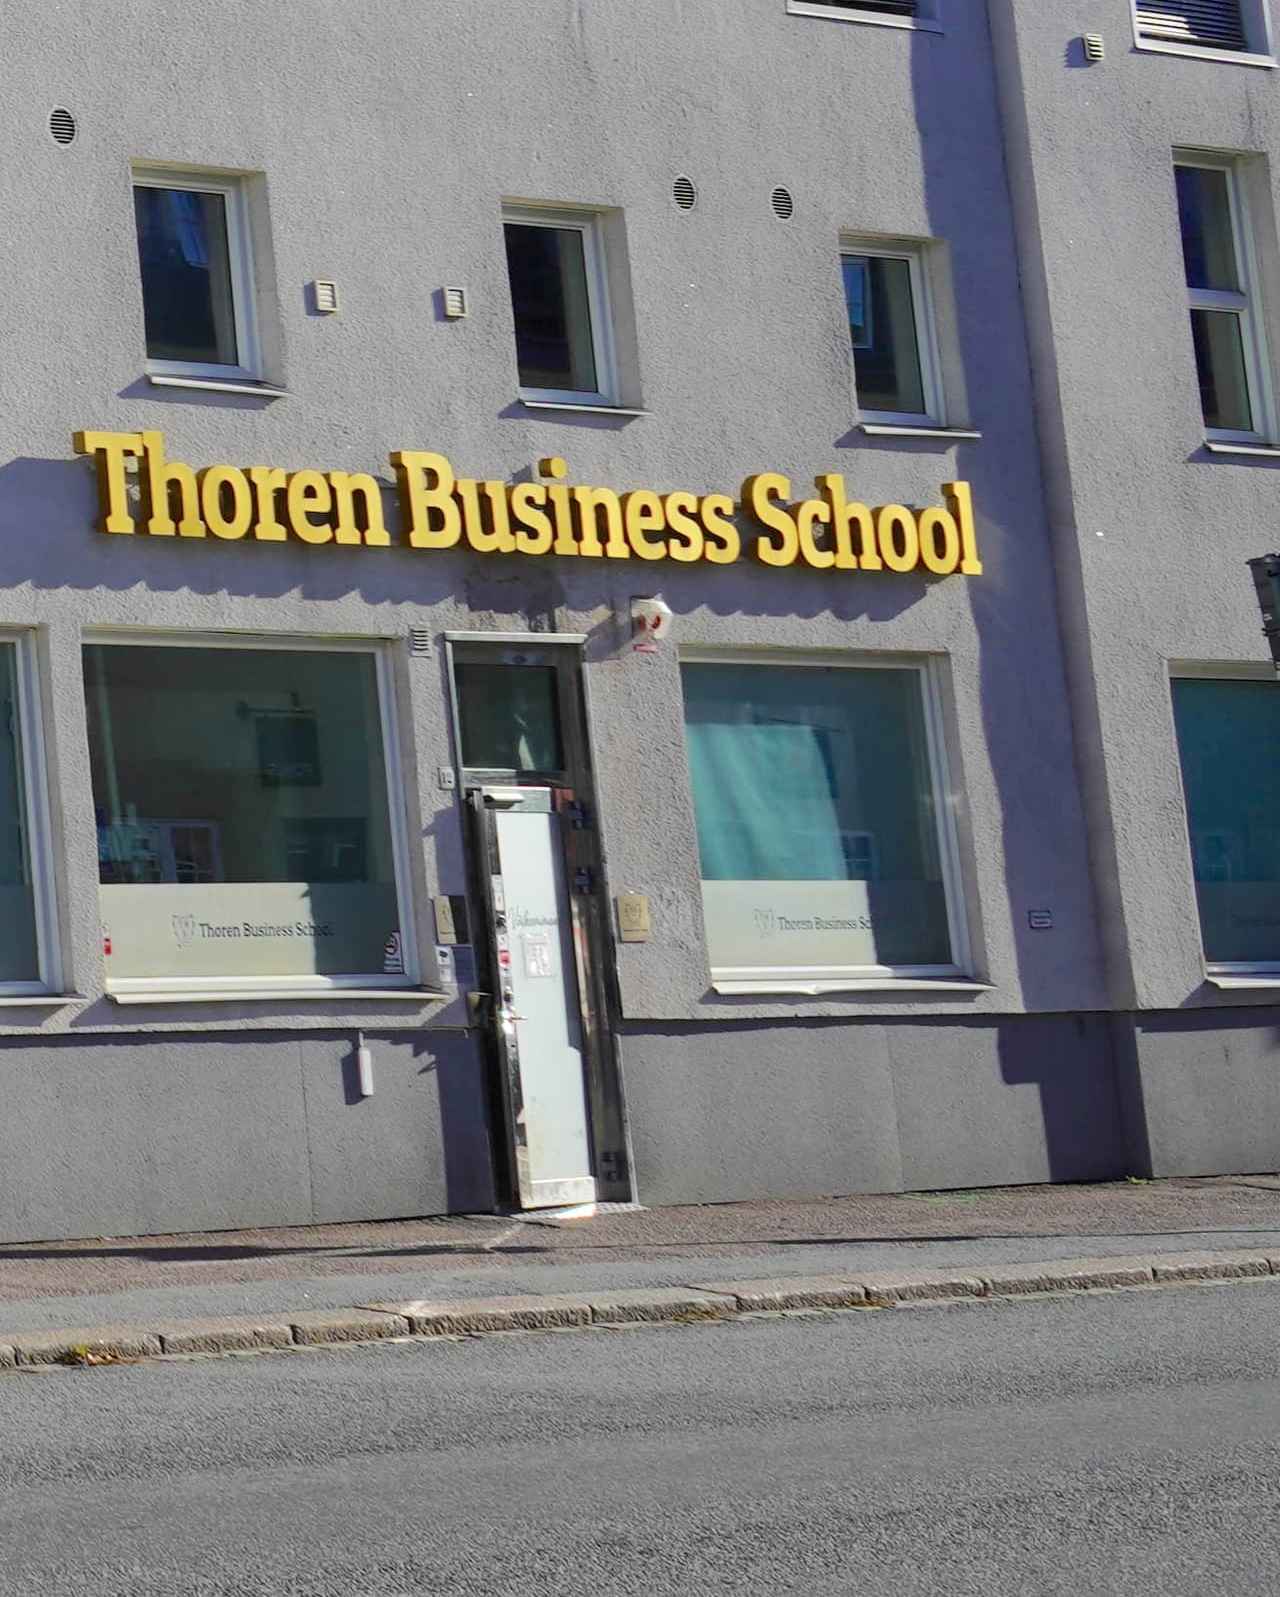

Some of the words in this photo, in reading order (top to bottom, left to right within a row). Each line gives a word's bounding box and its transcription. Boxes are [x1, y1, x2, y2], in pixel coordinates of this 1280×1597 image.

[73, 430, 391, 547] Thoren
[390, 450, 740, 564] Business
[741, 472, 983, 576] School
[199, 922, 240, 938] Thoren
[243, 922, 293, 938] Business
